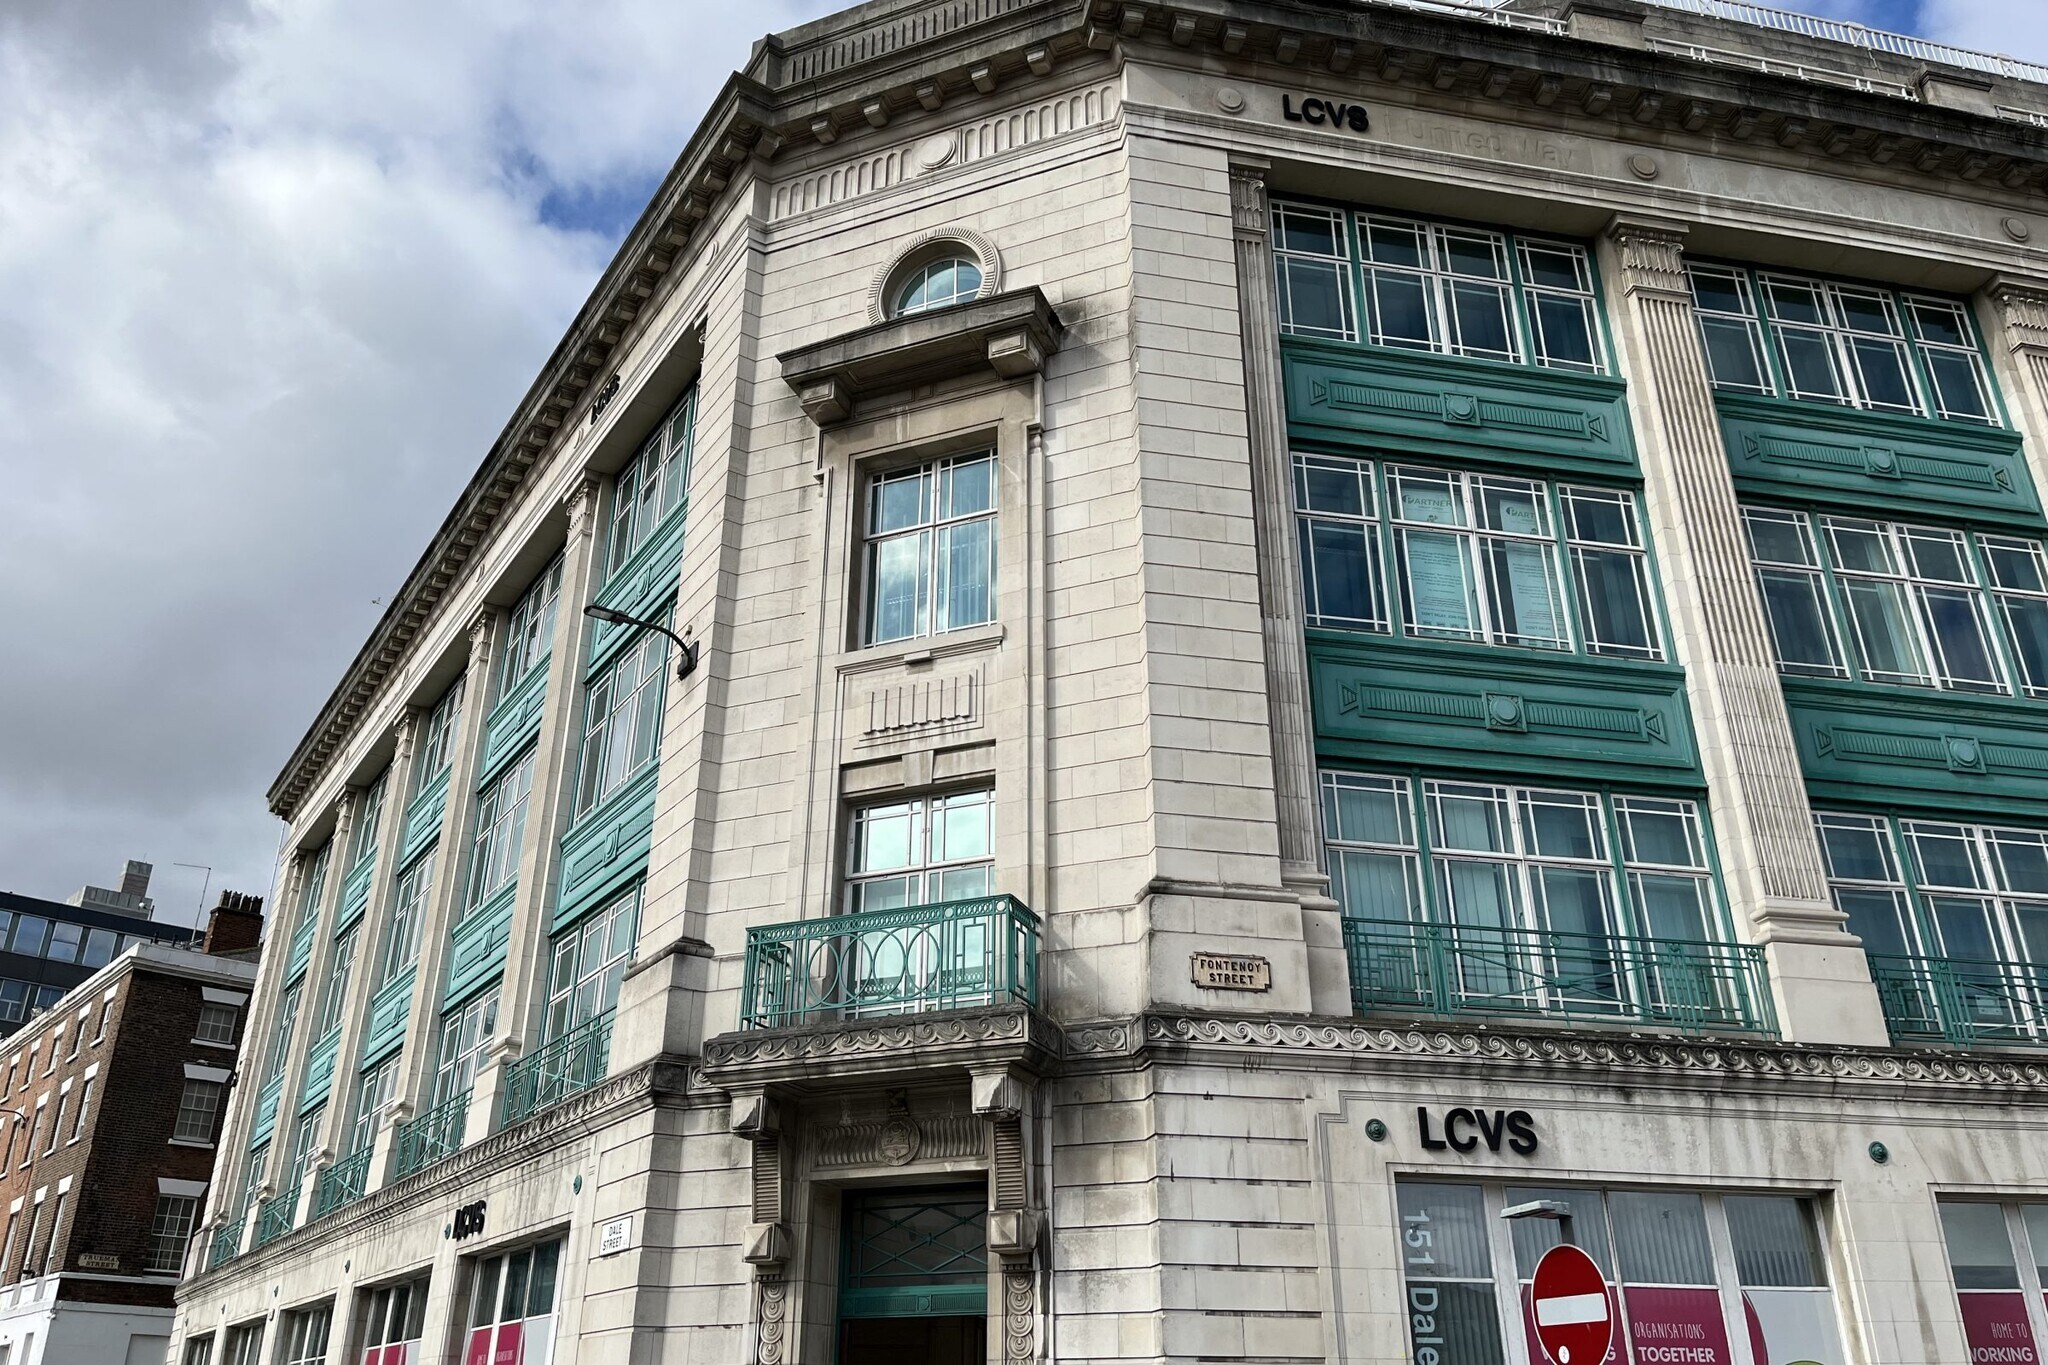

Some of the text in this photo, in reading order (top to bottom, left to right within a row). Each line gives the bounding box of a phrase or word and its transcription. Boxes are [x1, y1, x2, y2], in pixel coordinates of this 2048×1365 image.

[1282, 94, 1369, 132] LCVS
[1200, 959, 1261, 973] FONTENOY
[1209, 972, 1254, 985] STREET
[1417, 1106, 1538, 1155] LCVS
[609, 1223, 622, 1236] DALE
[1404, 1210, 1435, 1264] 151
[602, 1236, 622, 1251] STREET
[1410, 1287, 1444, 1365] Dale
[1634, 1321, 1705, 1340] ORGANISATIONS
[1990, 1322, 2028, 1339] HOME TO
[1638, 1346, 1715, 1363] TOGETHER
